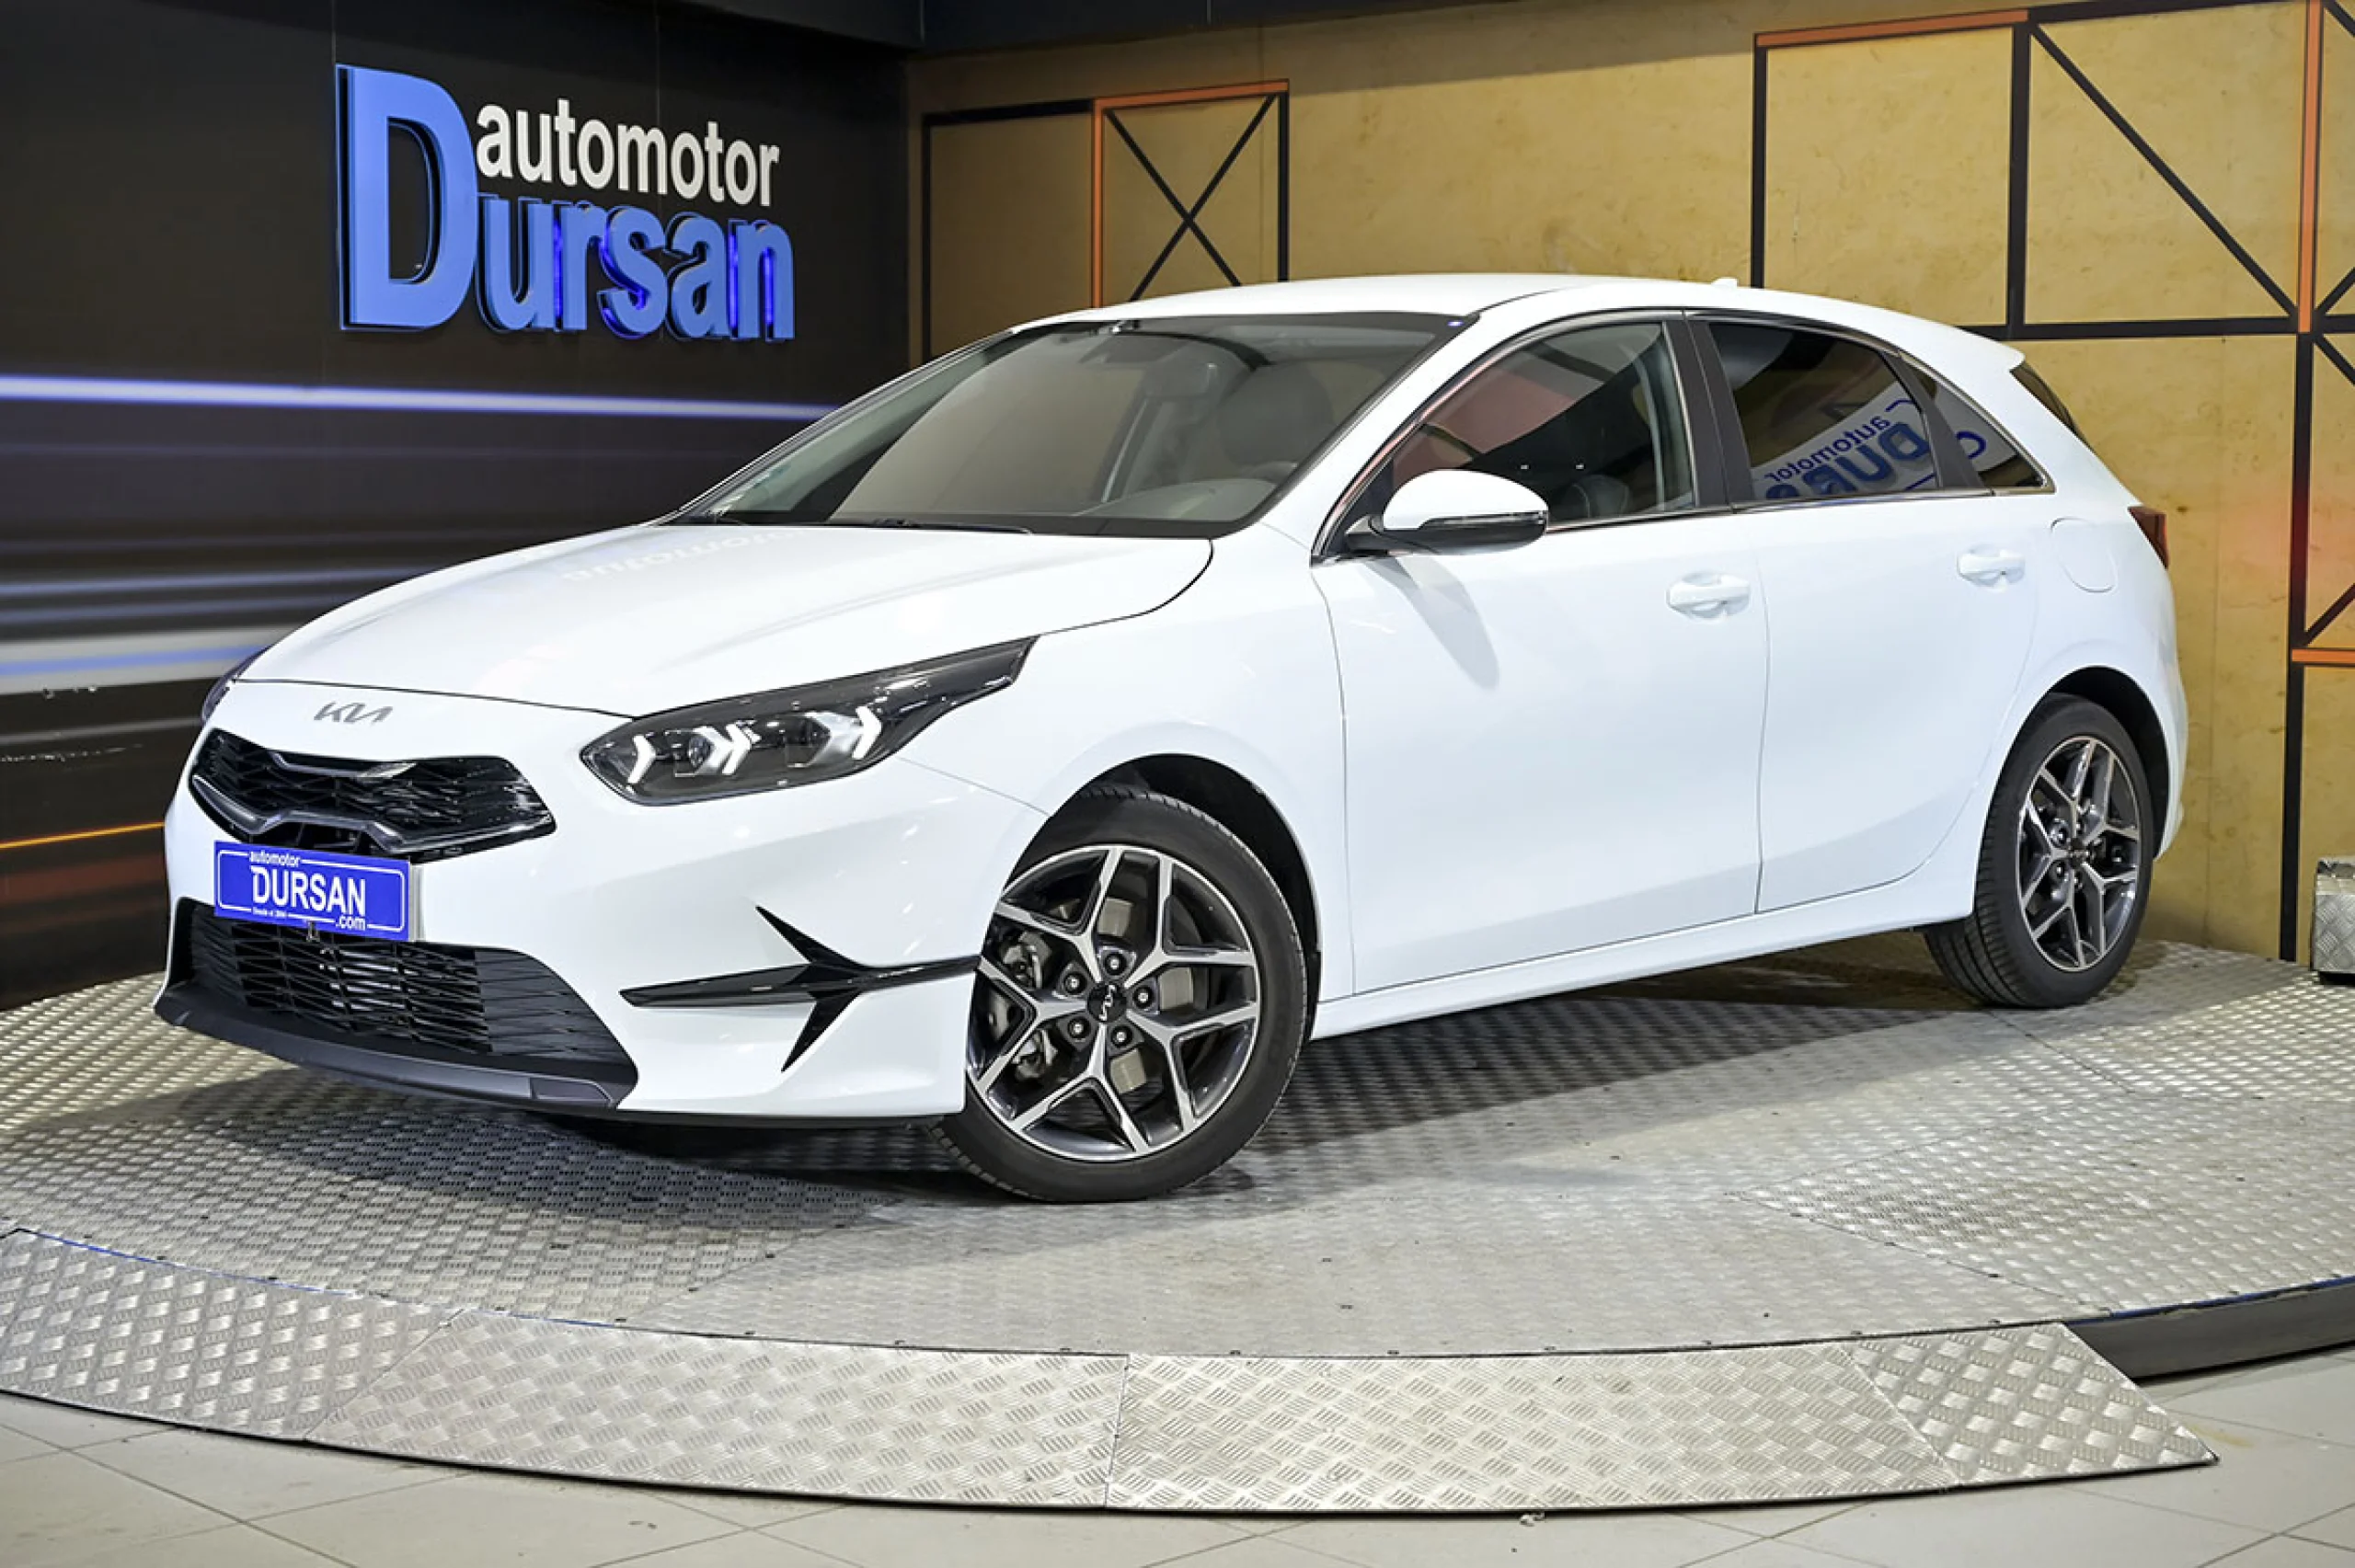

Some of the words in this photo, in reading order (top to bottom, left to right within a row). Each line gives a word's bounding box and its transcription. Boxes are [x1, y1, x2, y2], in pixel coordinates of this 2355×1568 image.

[476, 98, 780, 206] automotor
[336, 63, 795, 343] Dursan
[249, 850, 300, 867] automotor
[250, 864, 366, 917] DURSAN
[336, 916, 366, 932] .com
